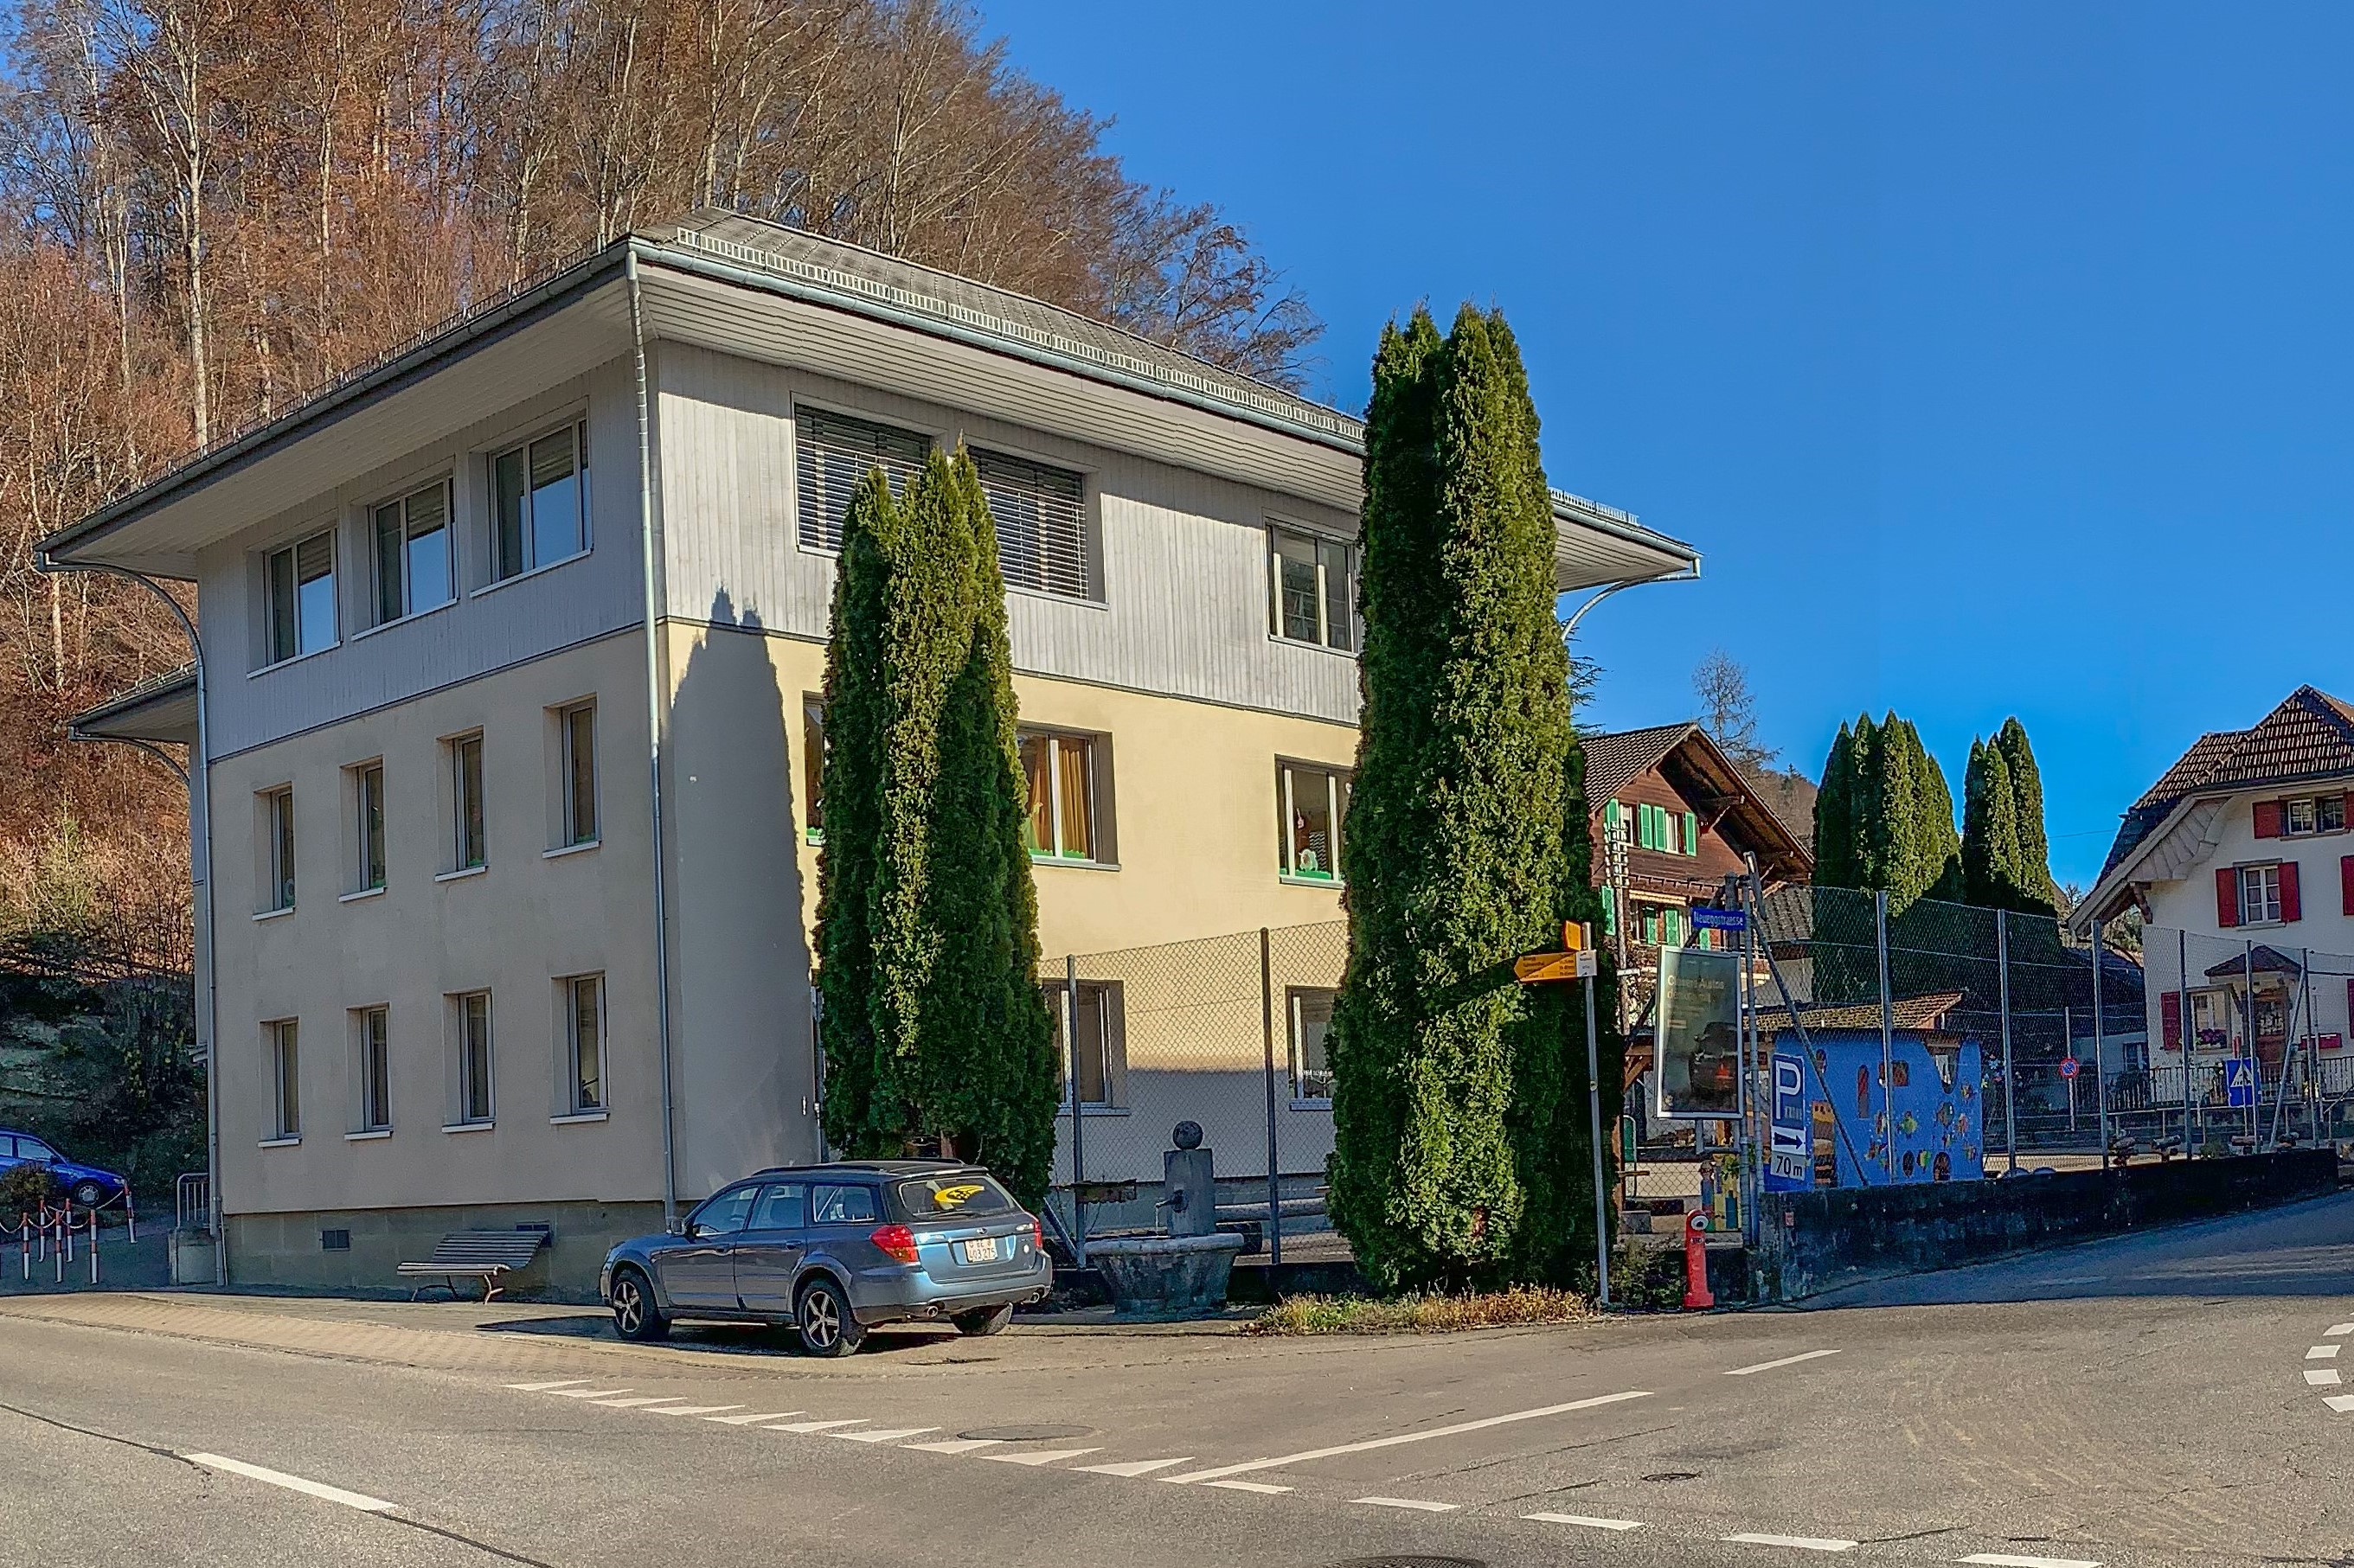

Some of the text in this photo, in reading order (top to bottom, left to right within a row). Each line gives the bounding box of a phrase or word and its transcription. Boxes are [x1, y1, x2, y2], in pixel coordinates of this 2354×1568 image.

[1775, 1060, 1801, 1119] P
[1775, 1155, 1803, 1177] 70 m
